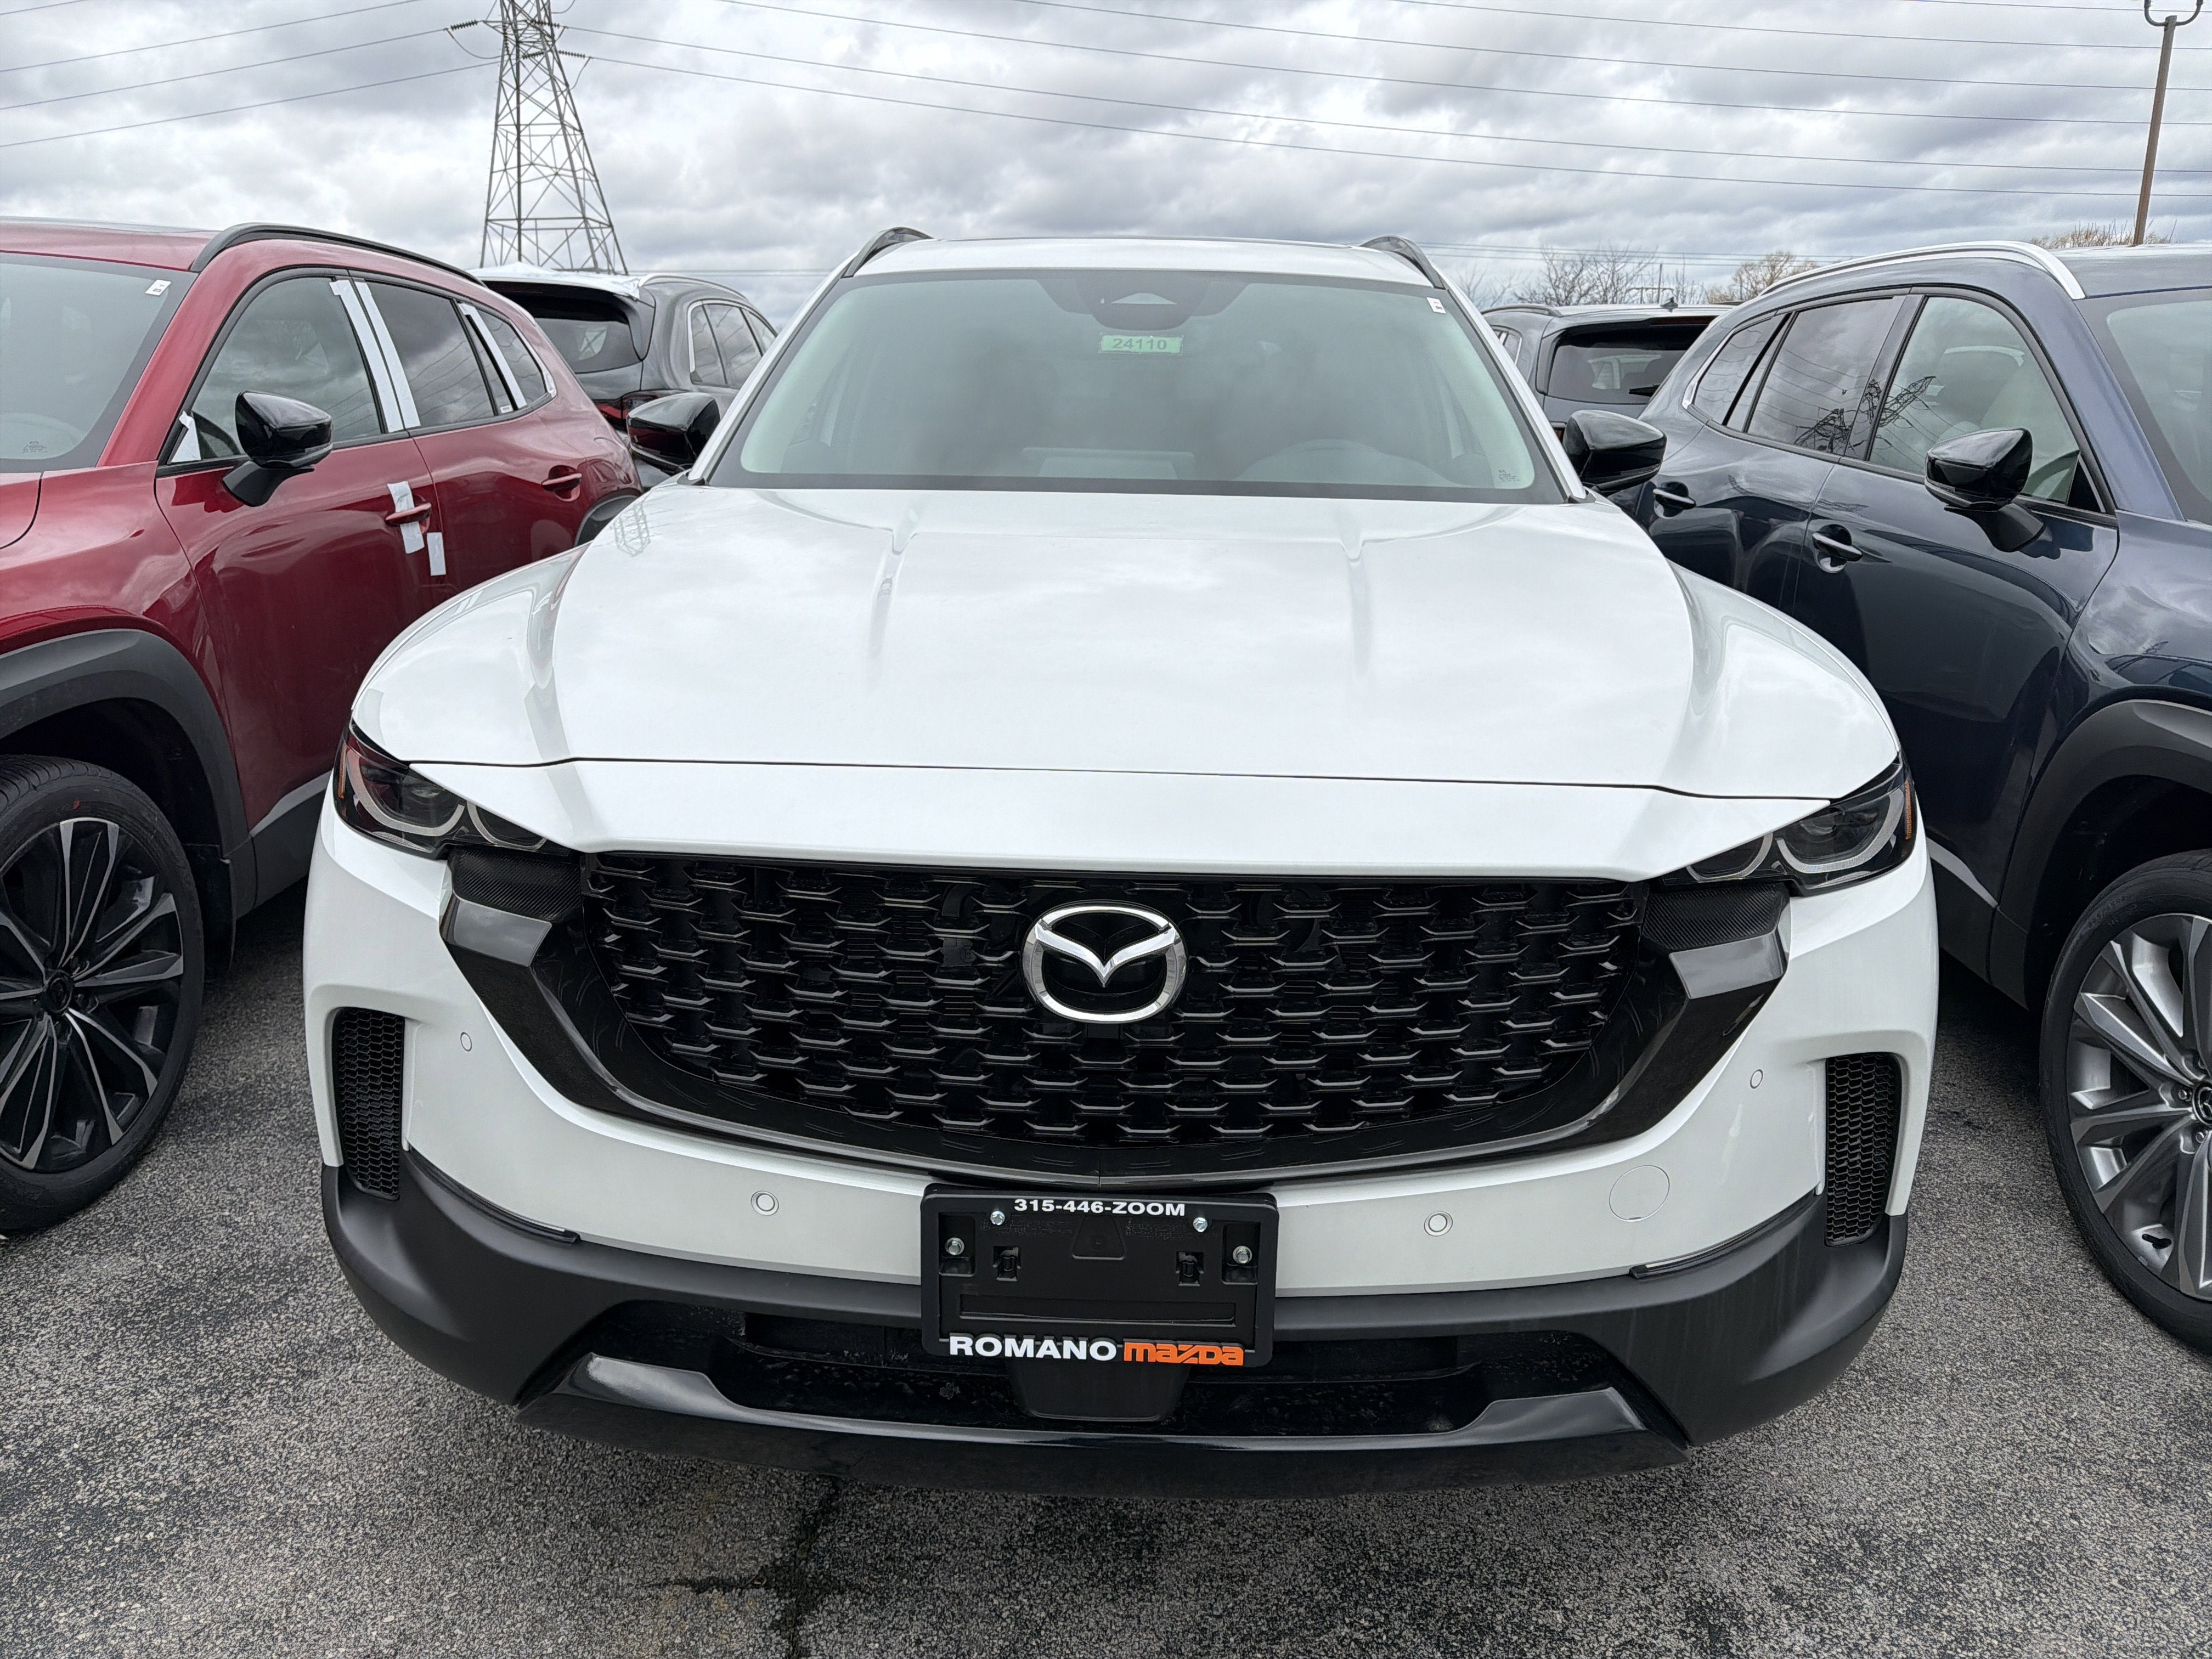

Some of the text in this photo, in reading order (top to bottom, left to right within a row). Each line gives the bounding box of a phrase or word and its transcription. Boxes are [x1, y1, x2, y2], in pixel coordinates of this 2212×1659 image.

[1112, 338, 1167, 350] 24110
[1014, 1199, 1186, 1216] 315-446-ZOOM
[949, 1335, 1117, 1361] ROMANO
